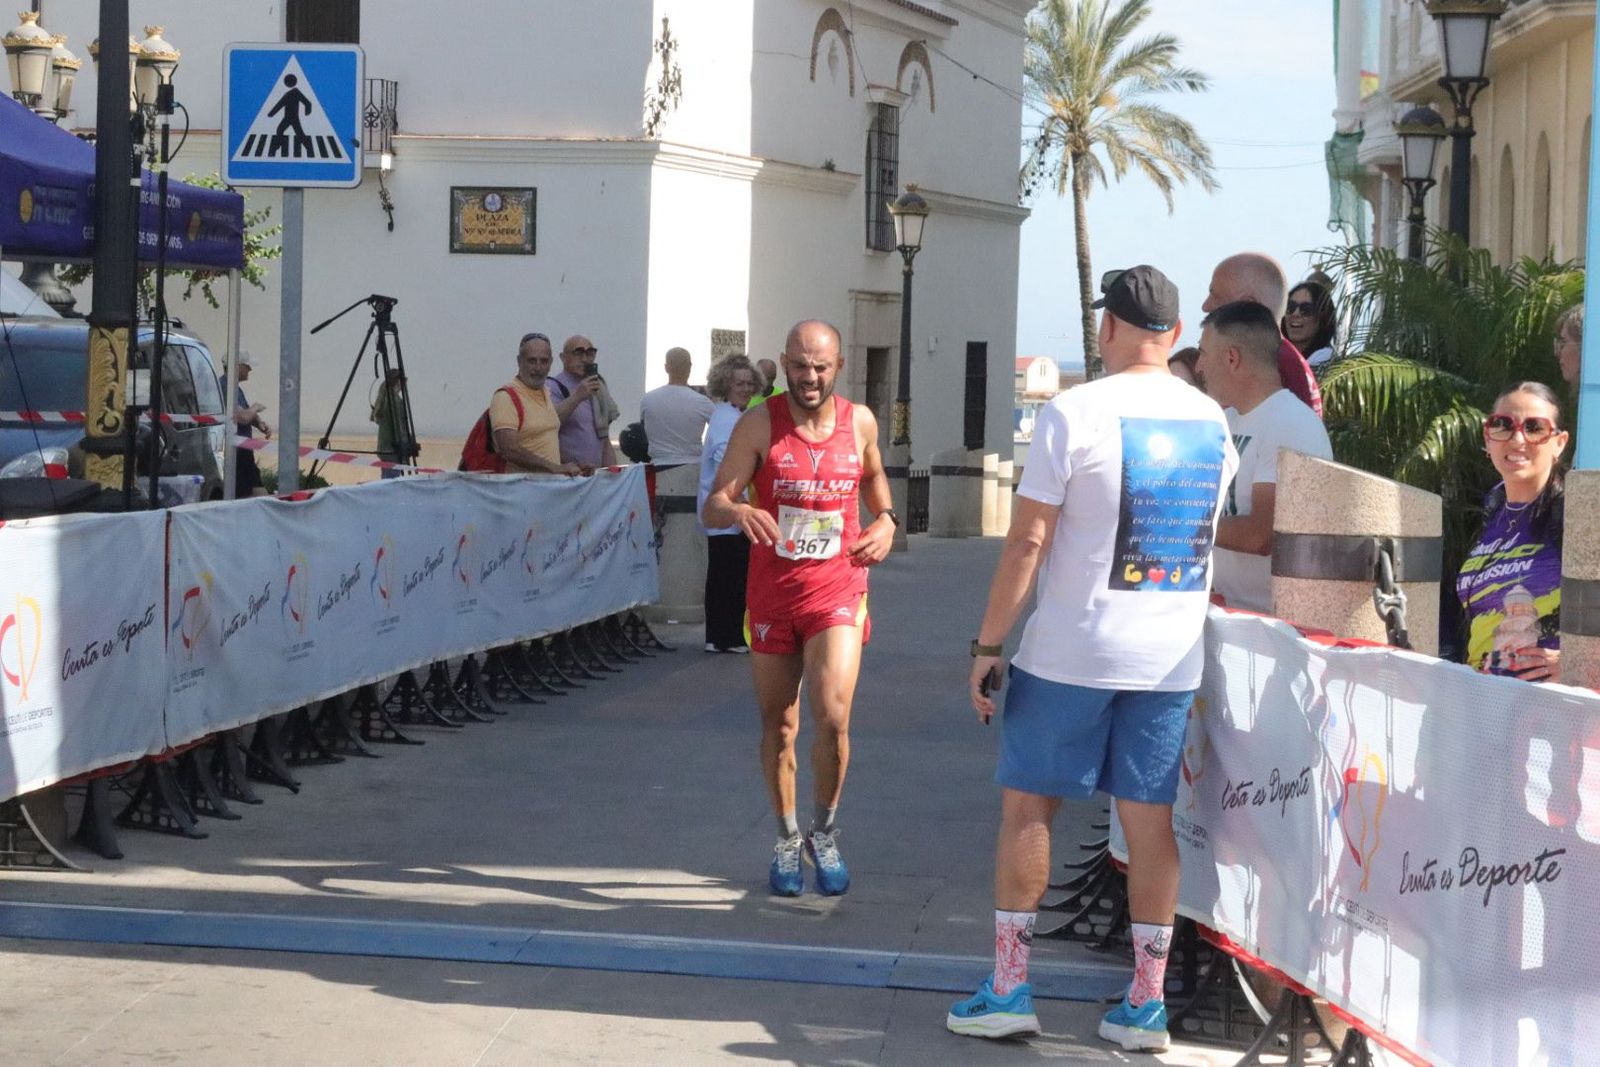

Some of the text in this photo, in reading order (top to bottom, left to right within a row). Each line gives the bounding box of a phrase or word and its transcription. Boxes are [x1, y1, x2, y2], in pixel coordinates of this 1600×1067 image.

[794, 537, 831, 556] 367
[61, 603, 157, 682] Ceuta es Deporte
[1253, 786, 1267, 807] es
[1269, 767, 1311, 819] Deporte
[1399, 846, 1567, 908] Ceuta es Deporte
